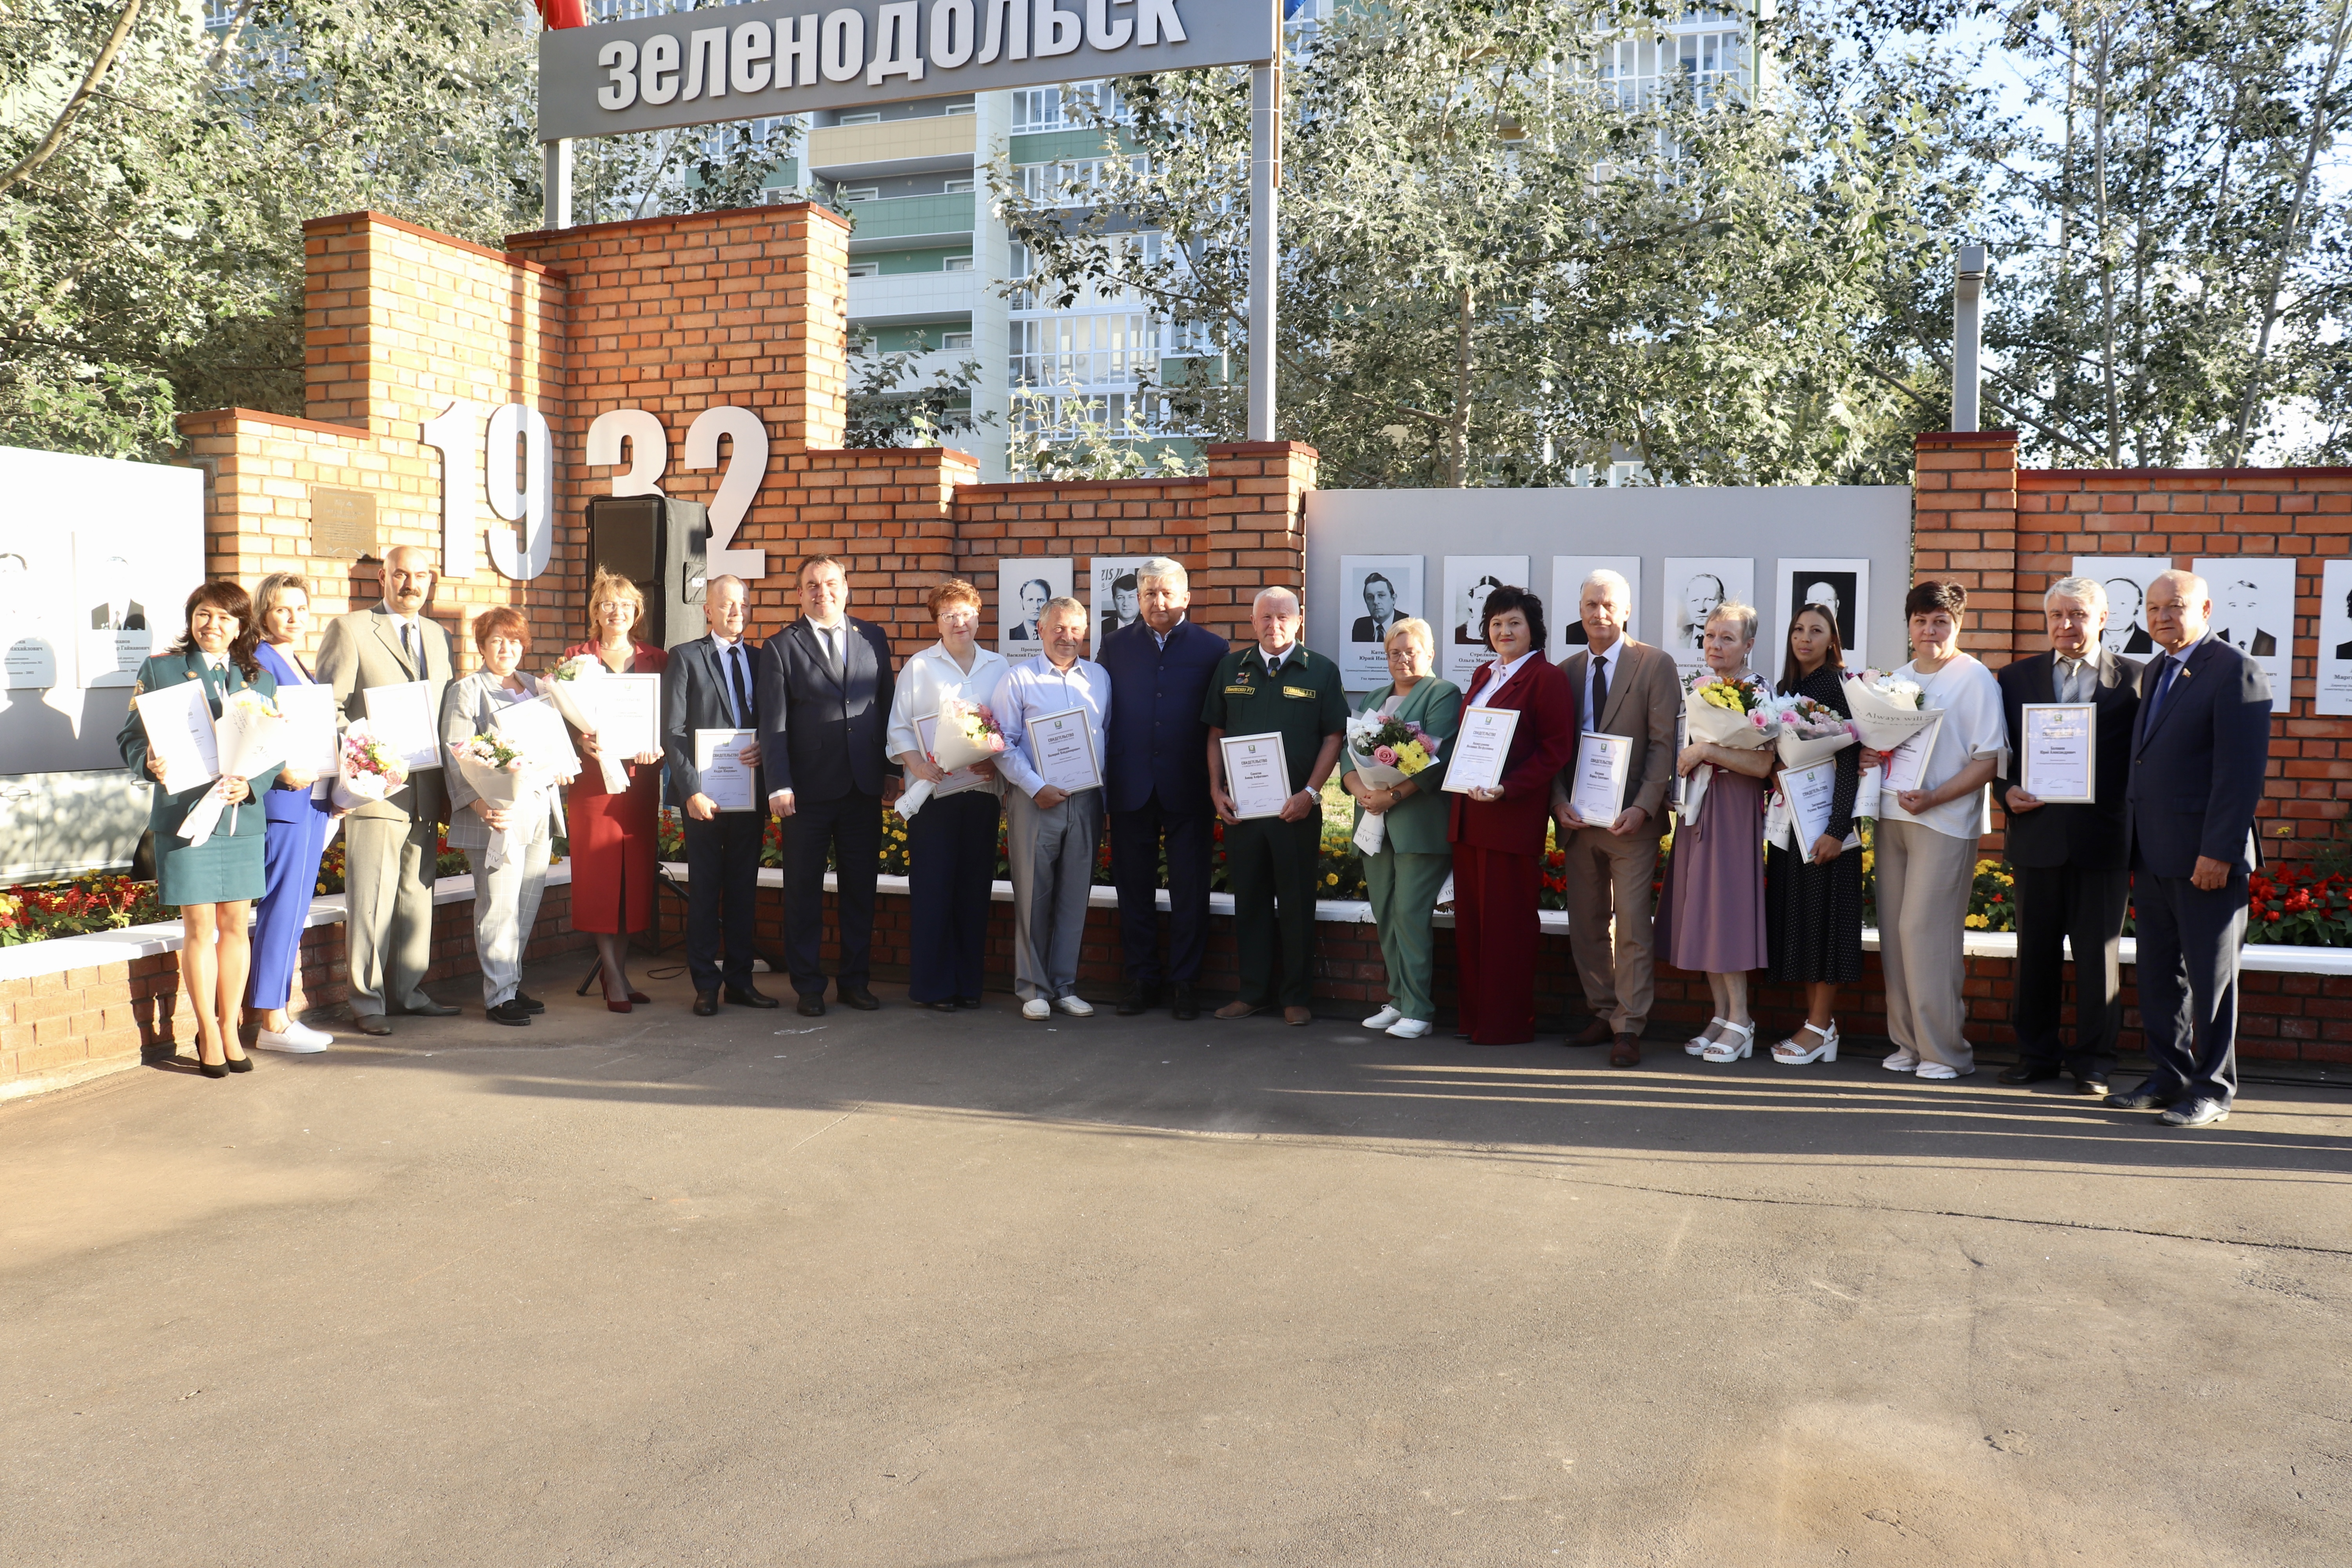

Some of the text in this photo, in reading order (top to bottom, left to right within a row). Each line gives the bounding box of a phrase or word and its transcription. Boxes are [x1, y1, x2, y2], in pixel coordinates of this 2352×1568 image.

[1866, 712, 1900, 722] Always
[1048, 732, 1074, 742] СВИДЕТЕЛЬСТВО
[1802, 785, 1828, 797] СВИДЕТЕЛЬСТВО
